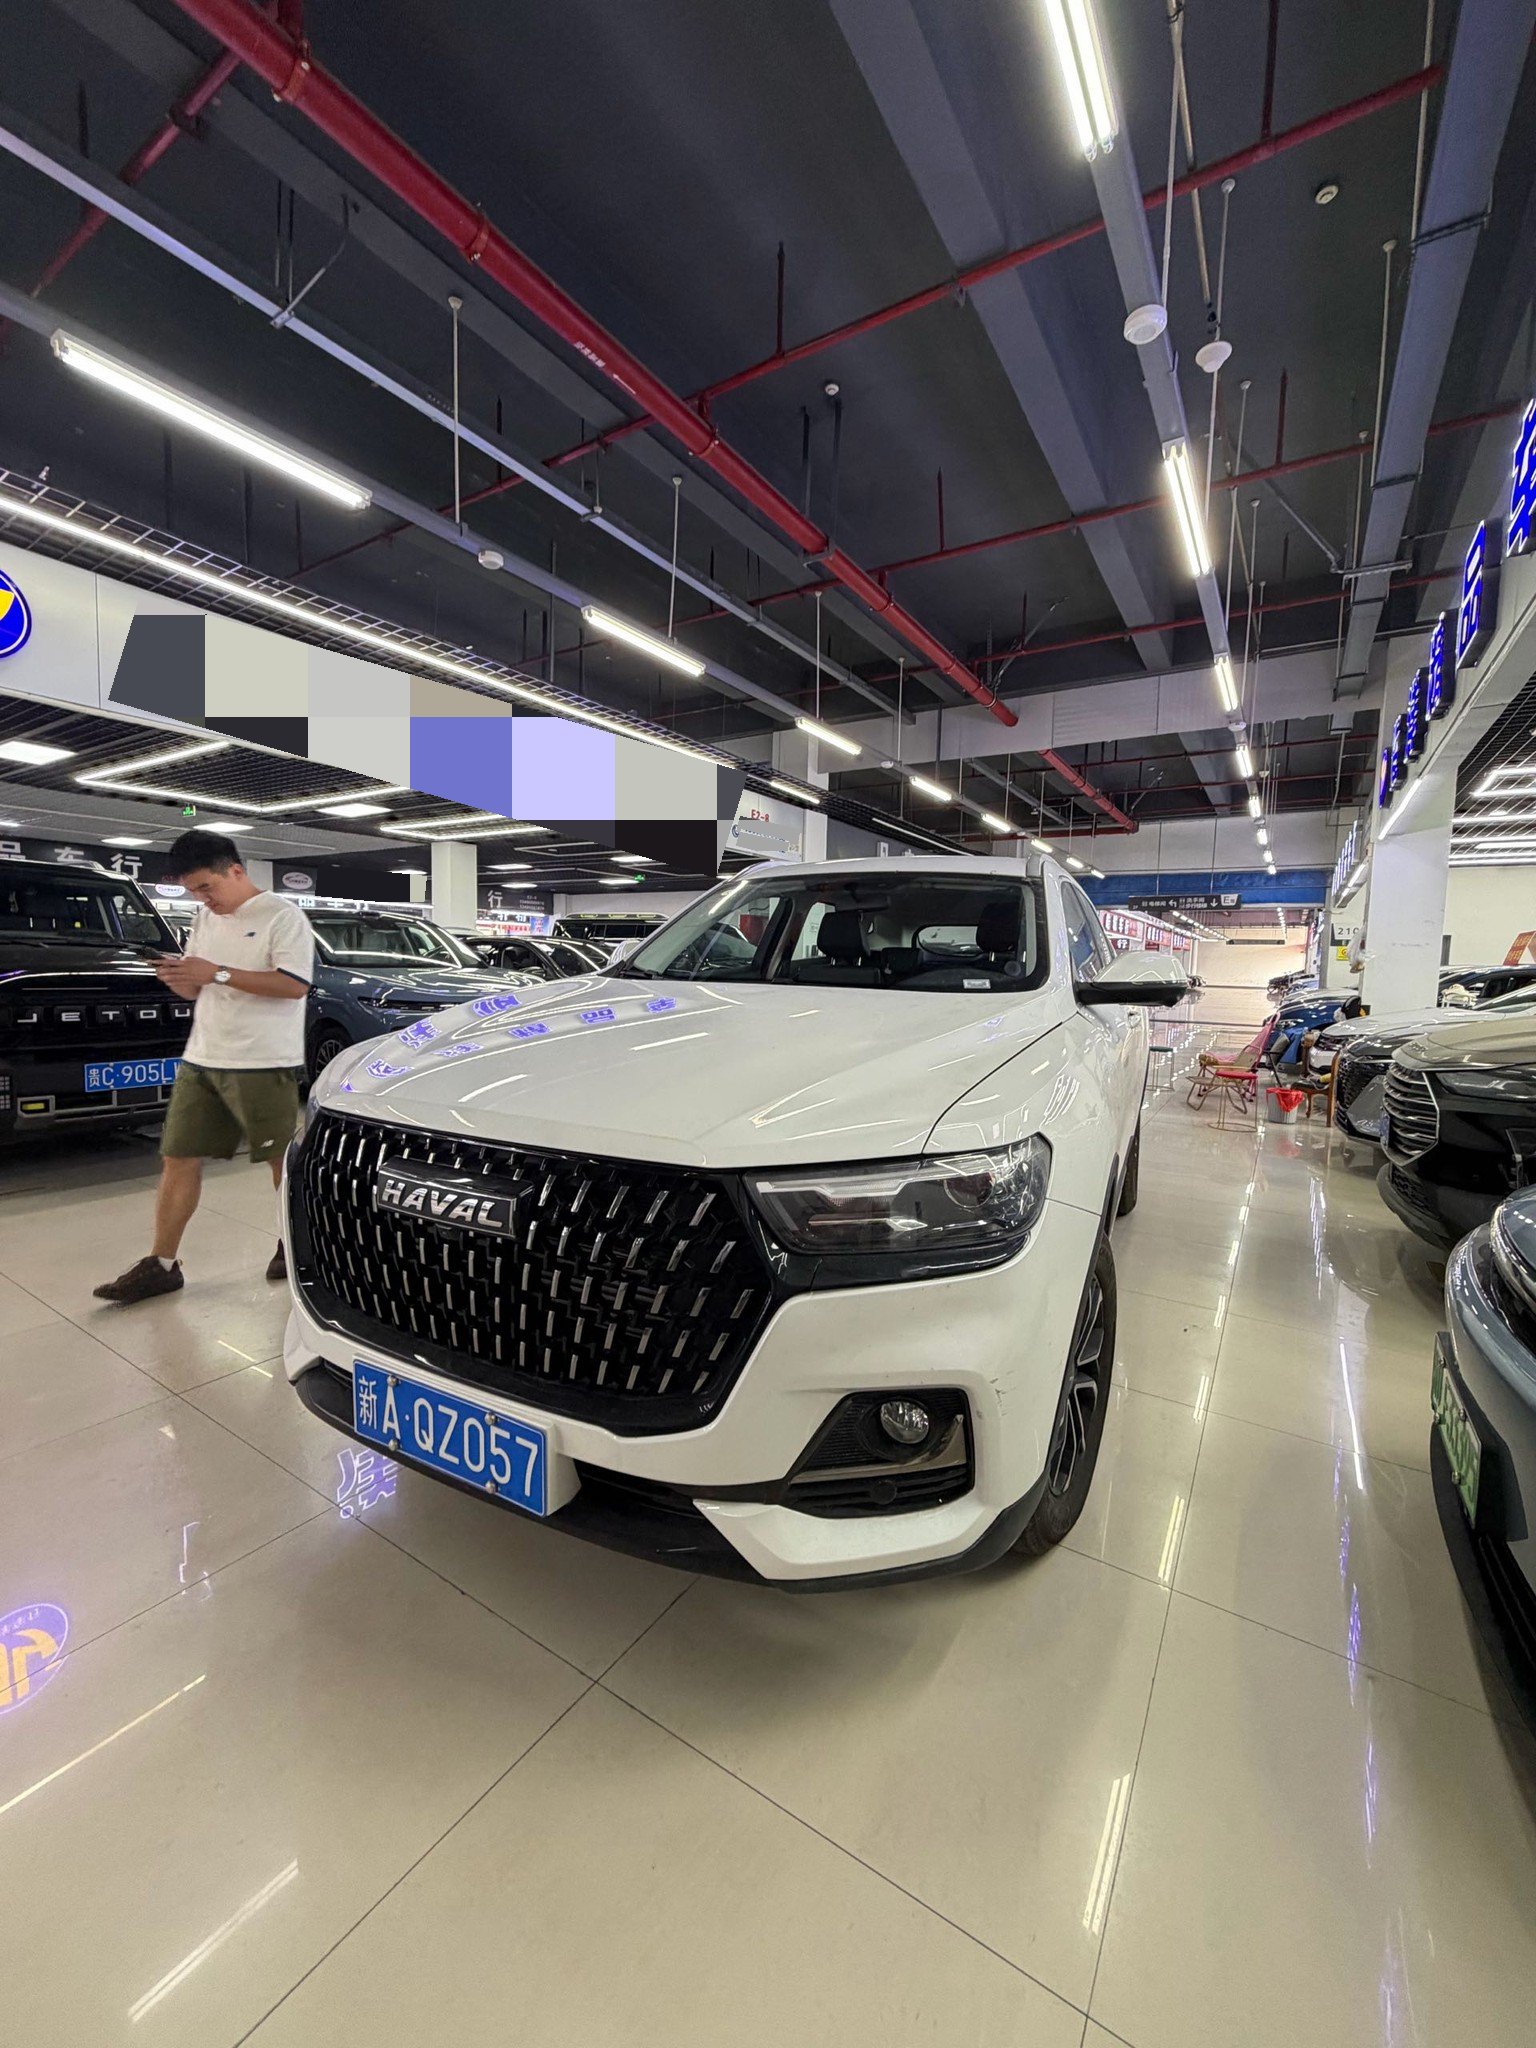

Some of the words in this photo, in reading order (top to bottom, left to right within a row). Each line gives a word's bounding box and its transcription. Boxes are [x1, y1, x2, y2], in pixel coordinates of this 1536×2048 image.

[487, 890, 503, 908] 行
[381, 1179, 504, 1228] HAVAL
[358, 1374, 539, 1498] 新A·QZ057
